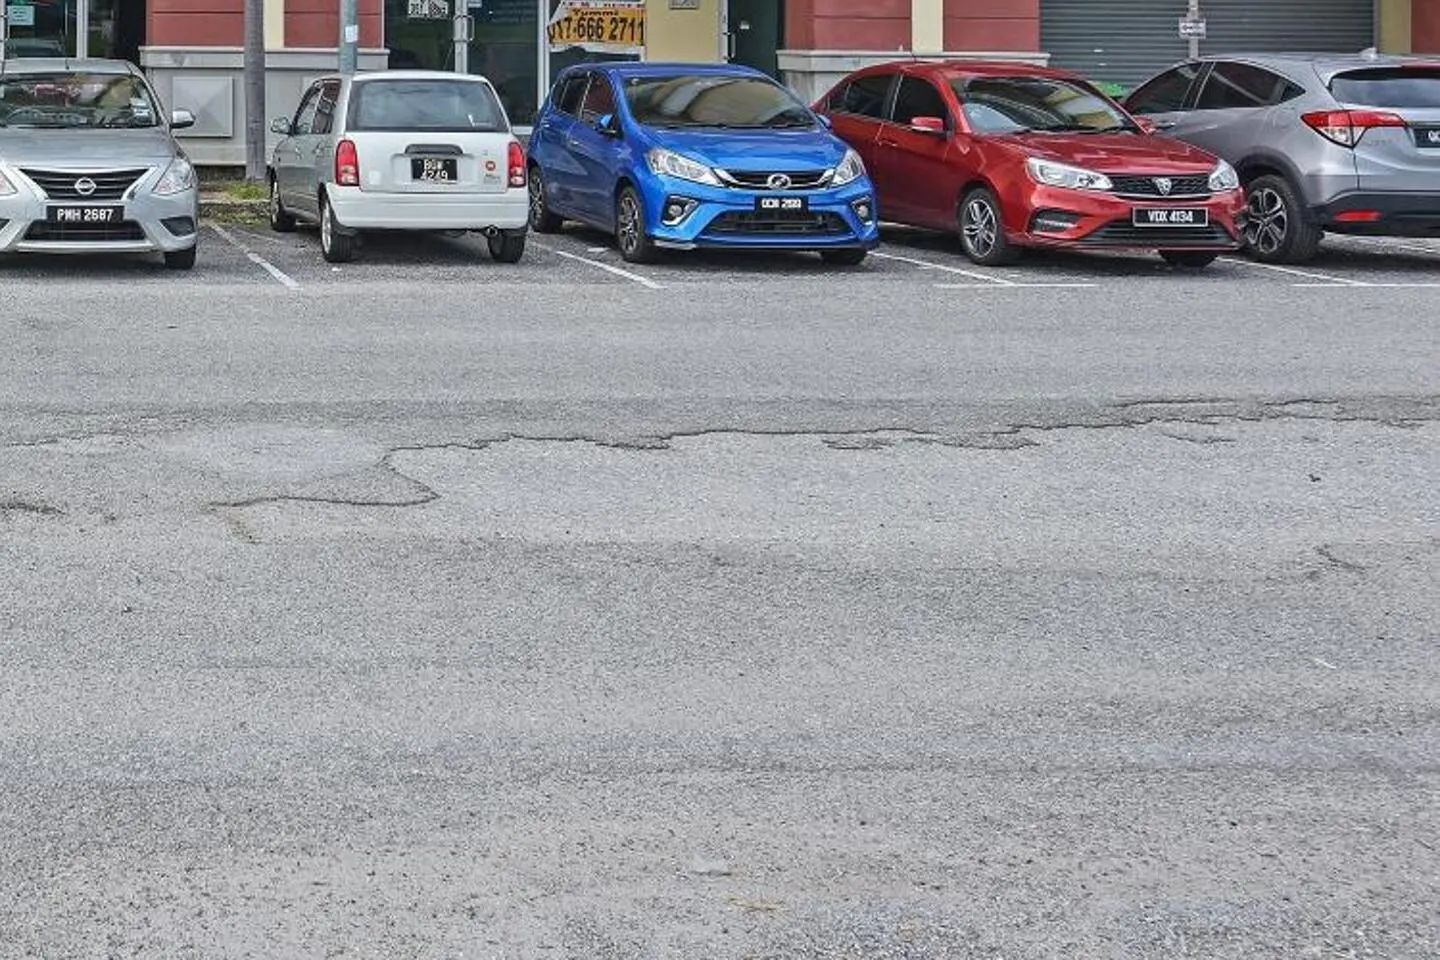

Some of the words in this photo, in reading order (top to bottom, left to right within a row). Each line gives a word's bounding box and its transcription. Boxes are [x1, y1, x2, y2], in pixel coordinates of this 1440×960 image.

[609, 17, 645, 45] 2711
[57, 208, 81, 222] PMH
[83, 208, 114, 222] 2687
